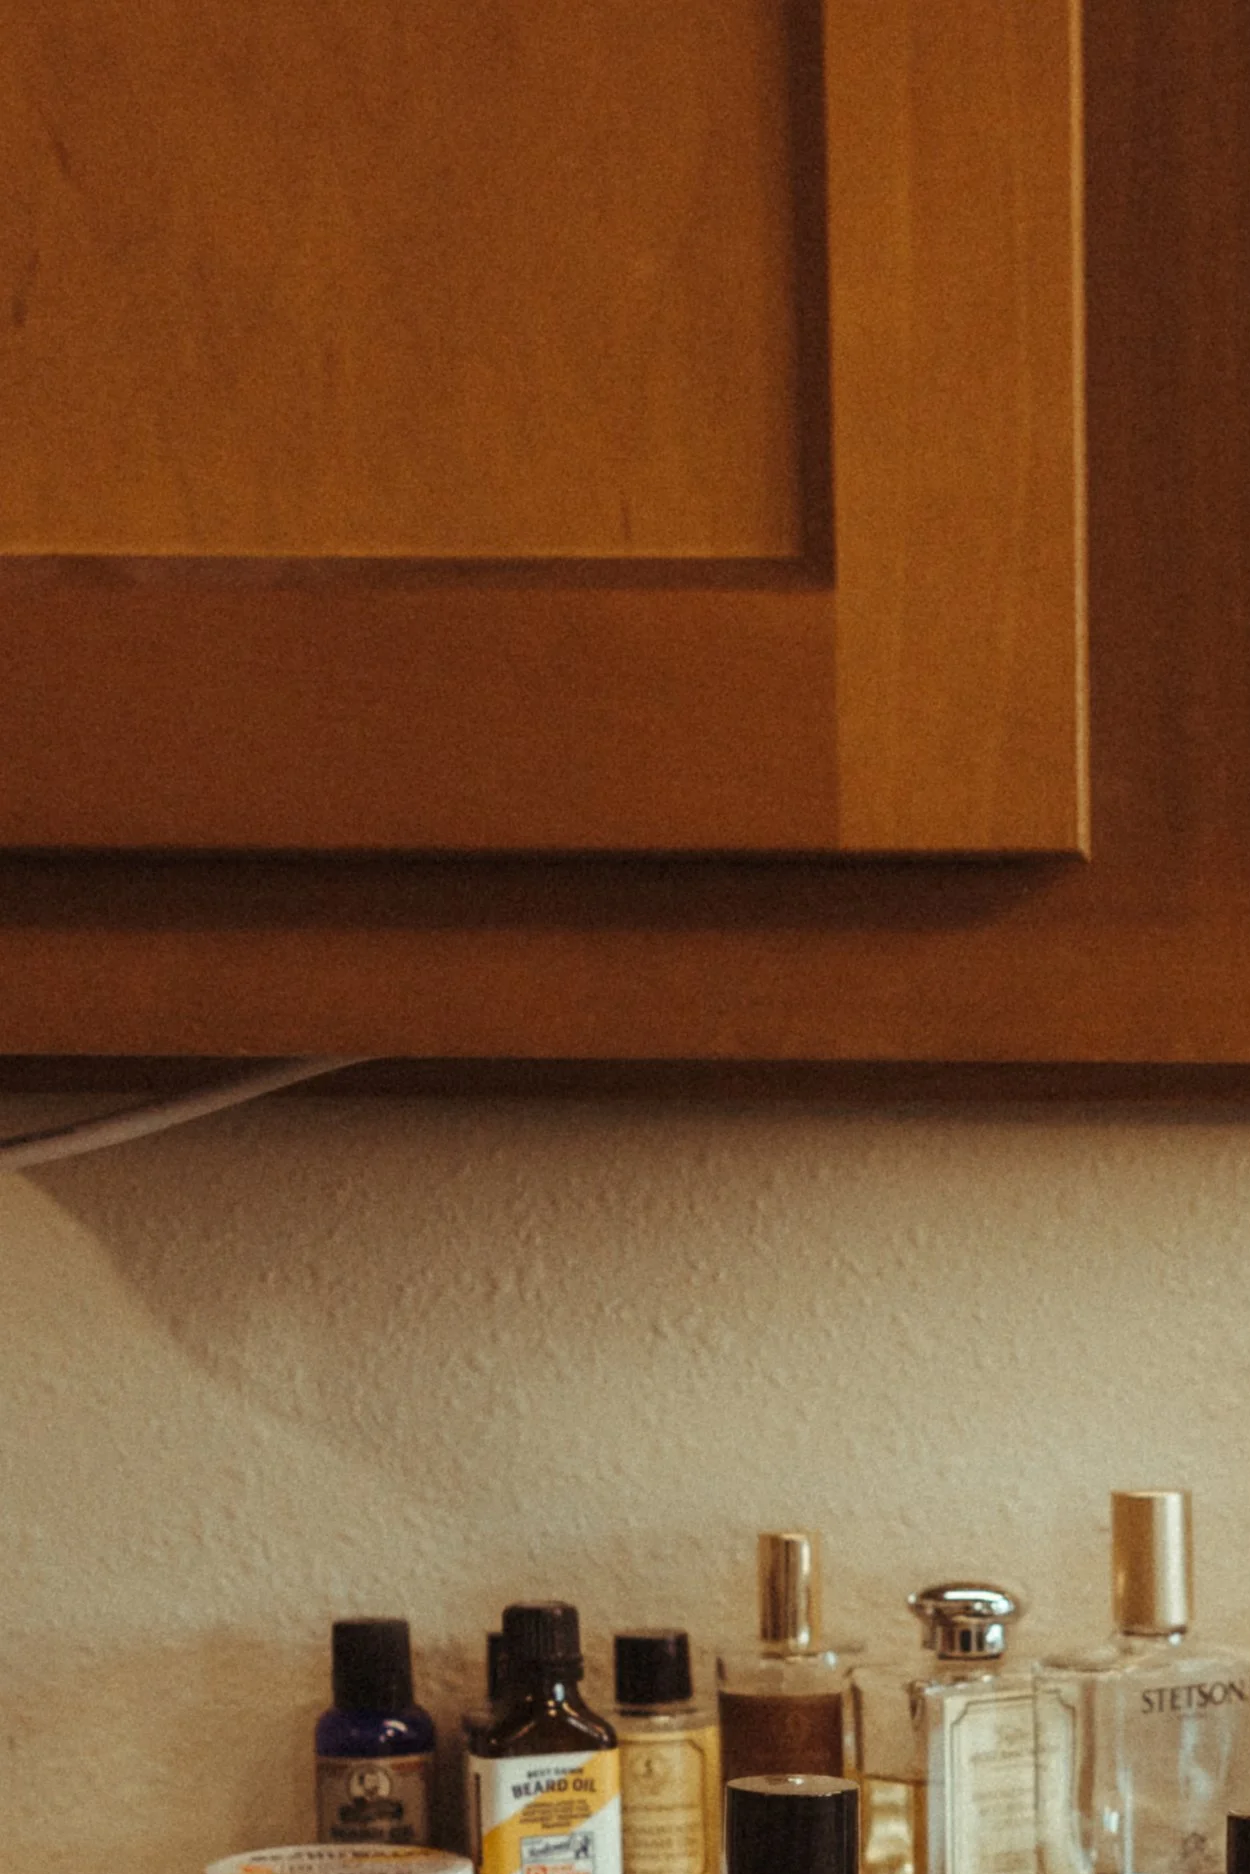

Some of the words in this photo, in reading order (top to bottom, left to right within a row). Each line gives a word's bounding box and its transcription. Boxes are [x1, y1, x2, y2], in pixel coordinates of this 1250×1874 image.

[1141, 1680, 1246, 1714] STETSON
[511, 1779, 568, 1799] BEARD
[573, 1778, 597, 1793] OIL
